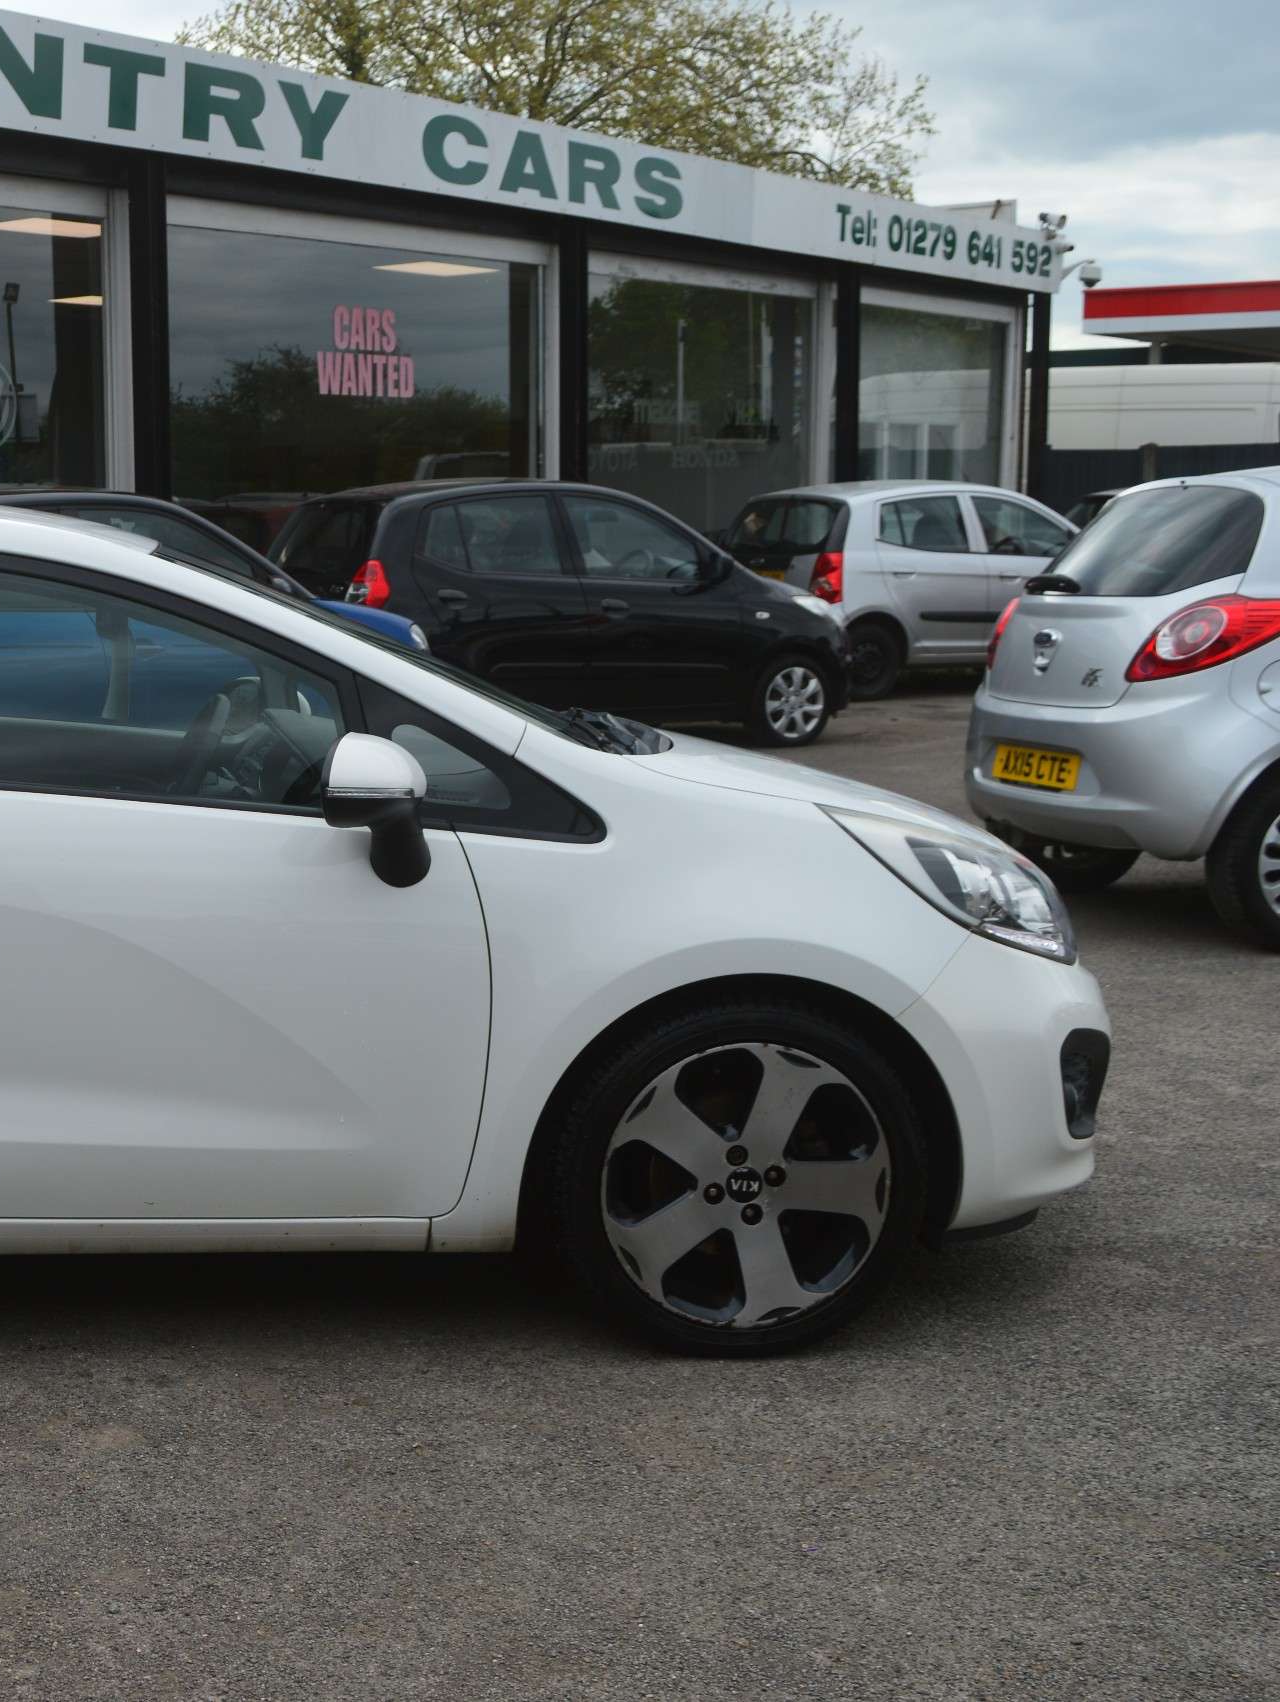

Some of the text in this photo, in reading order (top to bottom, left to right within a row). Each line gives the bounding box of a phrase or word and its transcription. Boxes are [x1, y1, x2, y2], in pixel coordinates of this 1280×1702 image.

[422, 114, 684, 220] CARS
[836, 203, 1053, 277] Tel: 01279 641 592
[333, 304, 397, 353] CARS
[317, 351, 416, 398] WANTED
[1002, 750, 1071, 784] AX15 CTE
[730, 1178, 760, 1192] KIA
